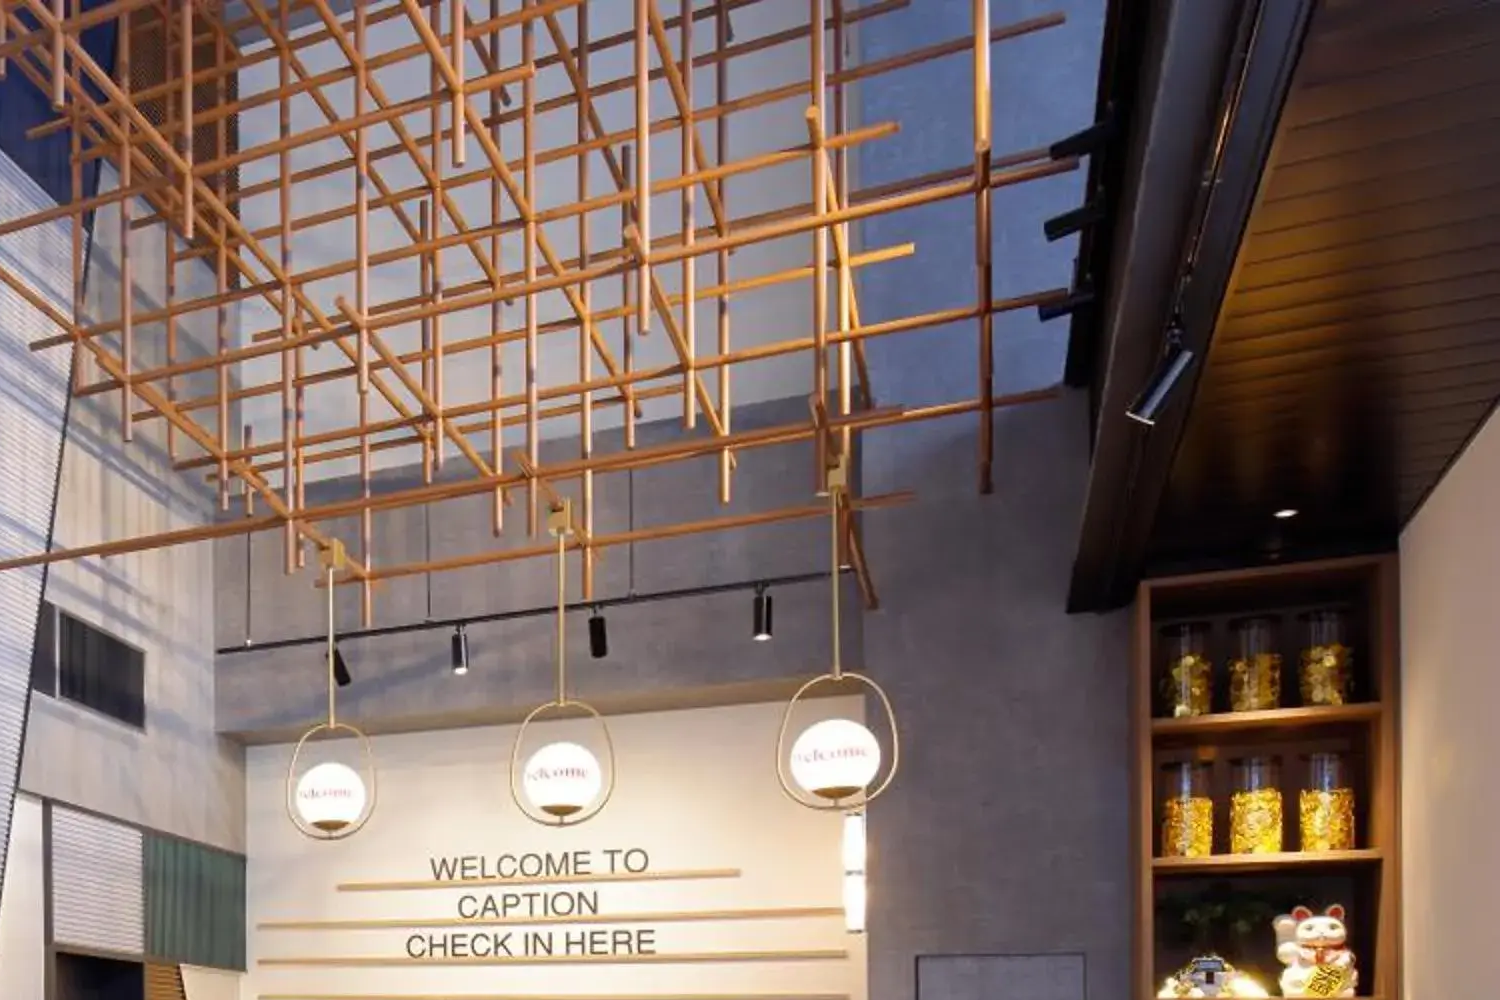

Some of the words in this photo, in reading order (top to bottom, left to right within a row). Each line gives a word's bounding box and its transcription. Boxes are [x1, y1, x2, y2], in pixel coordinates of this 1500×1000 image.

[429, 850, 593, 882] WELCOME
[602, 847, 649, 875] TO
[457, 890, 599, 920] CAPTION
[405, 932, 511, 959] CHECK
[524, 932, 553, 957] IN
[565, 929, 657, 956] HERE
